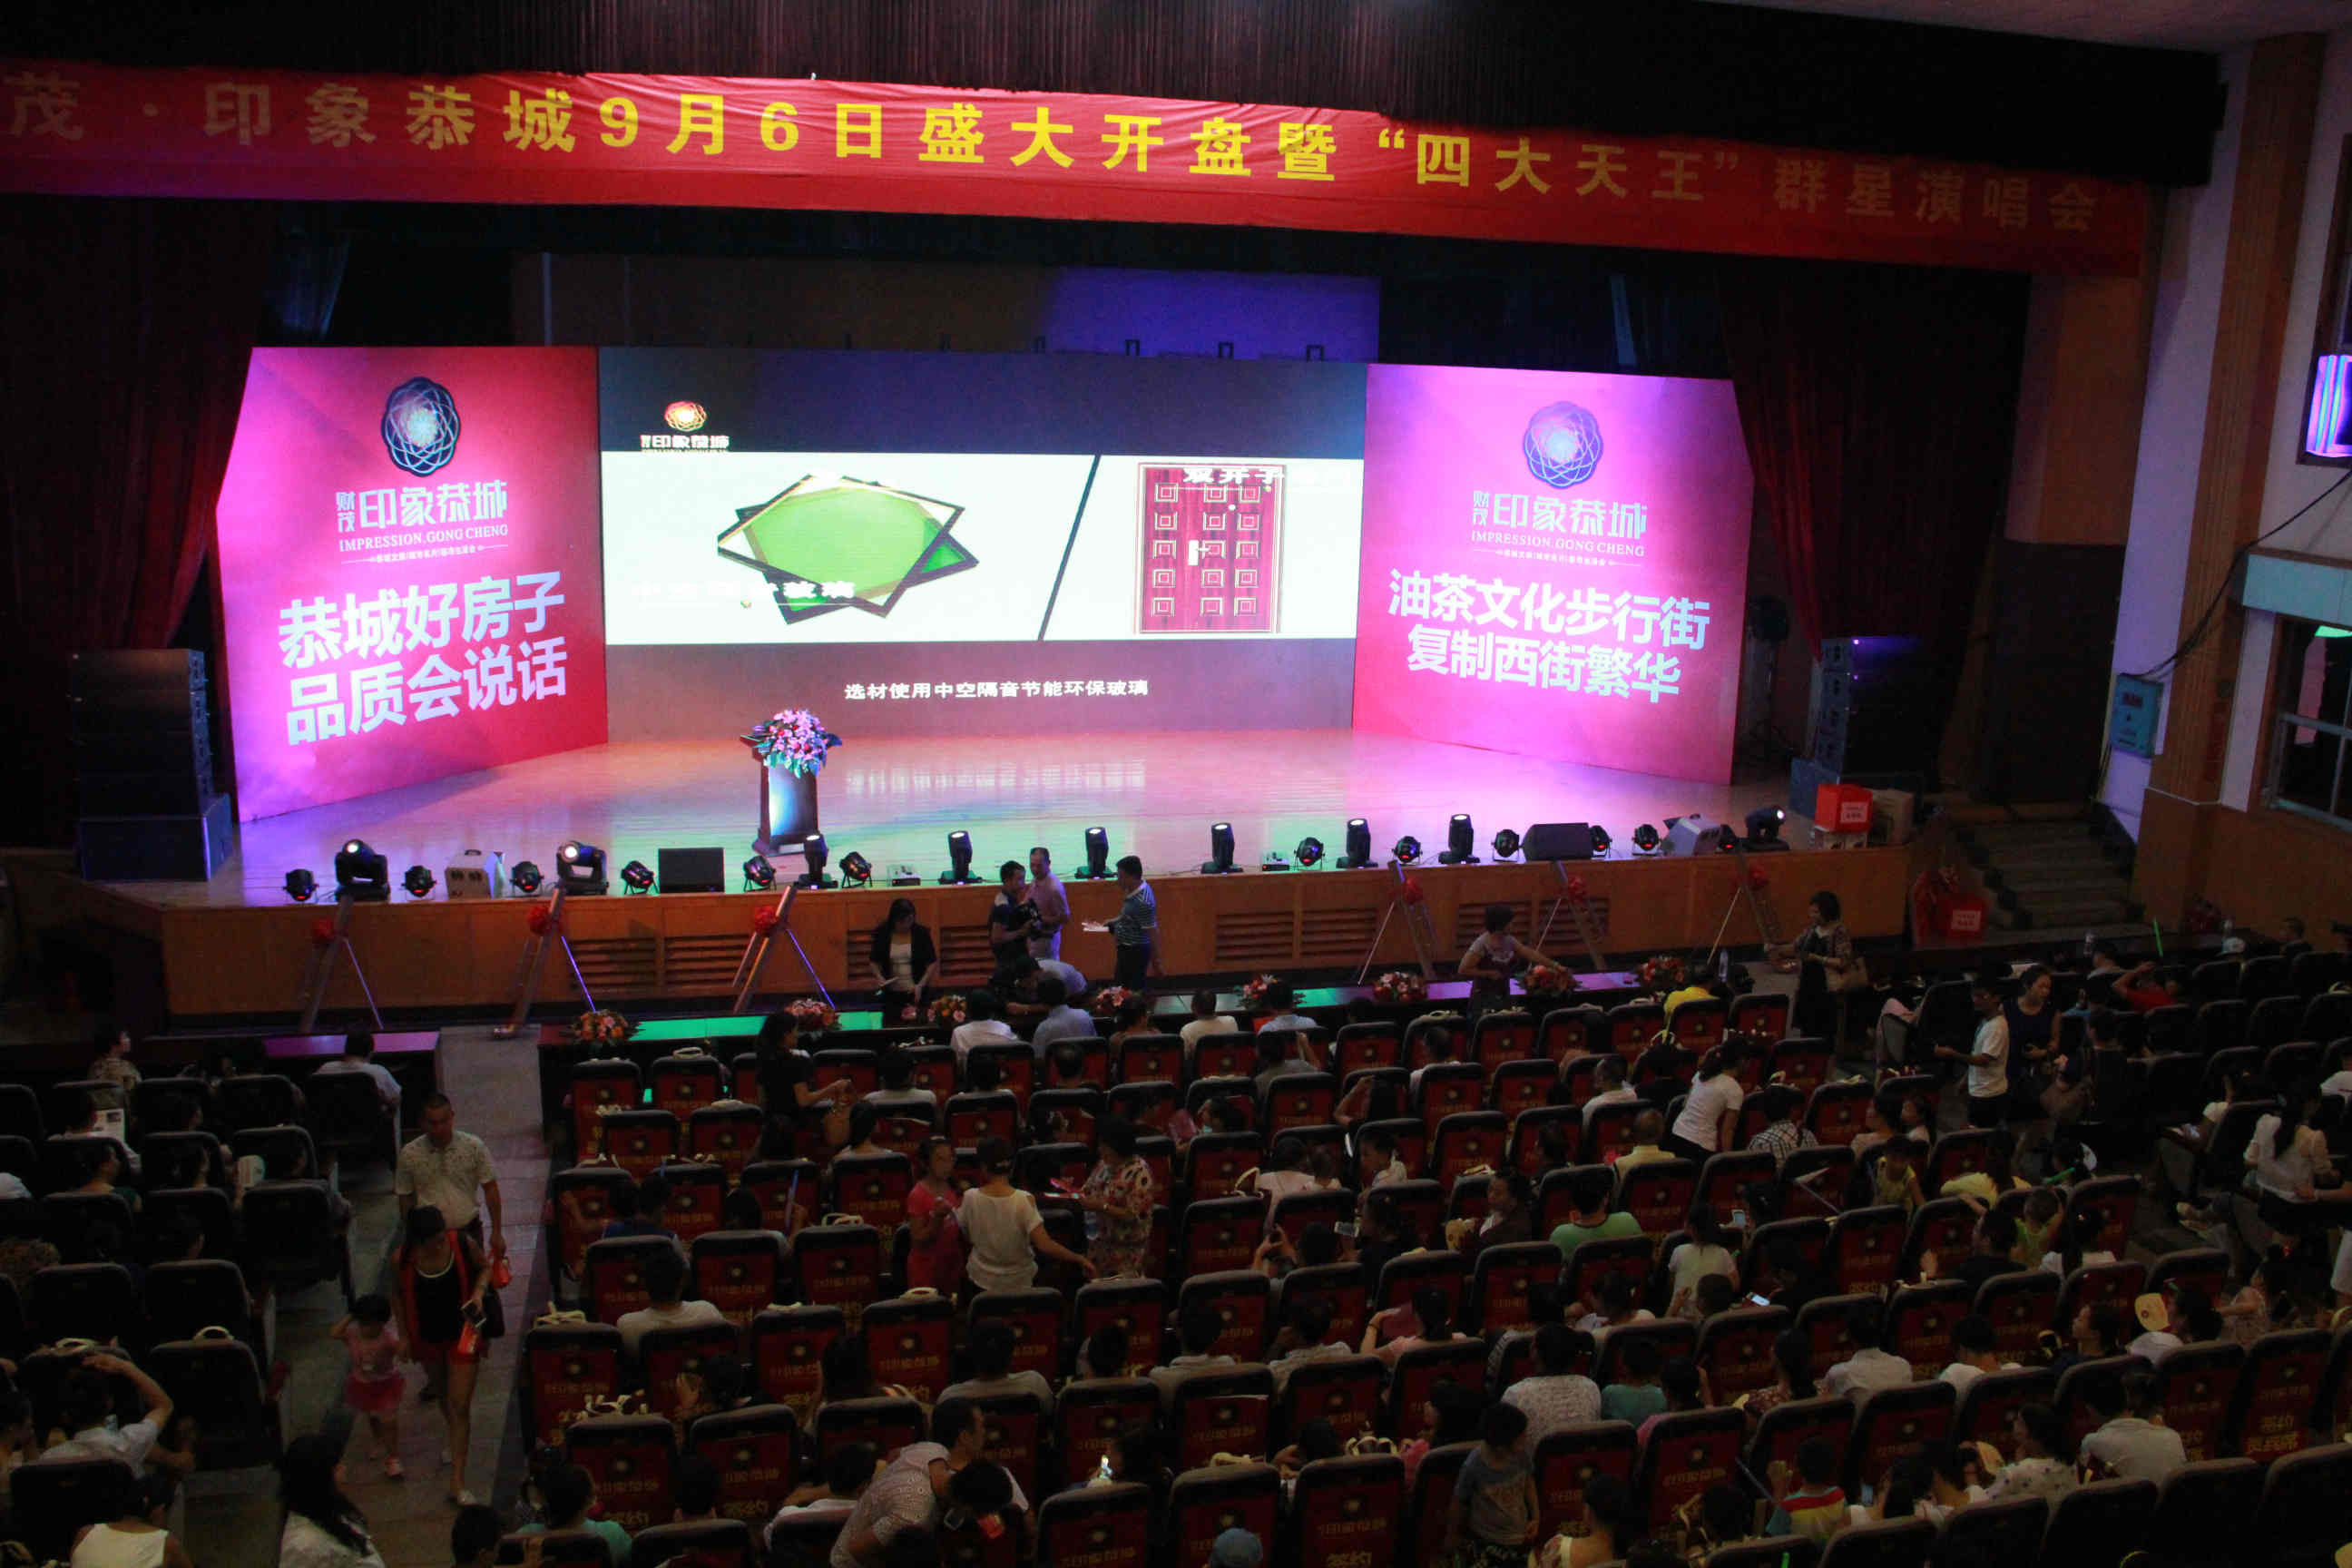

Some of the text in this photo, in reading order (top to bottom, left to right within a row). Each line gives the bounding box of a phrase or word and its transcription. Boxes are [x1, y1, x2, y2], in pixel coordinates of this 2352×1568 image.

[358, 478, 509, 529] 印象恭城
[1493, 493, 1648, 540] 印象恭城
[466, 524, 509, 540] CHENG
[1596, 542, 1645, 557] CHENG
[278, 570, 565, 670] 恭城好房子
[1387, 567, 1710, 651] 油茶文化步行街
[1407, 623, 1682, 704] 复制西街繁华
[287, 635, 568, 746] 品质会说话
[844, 680, 1149, 700] 选材使用中空隔音节能环保玻璃
